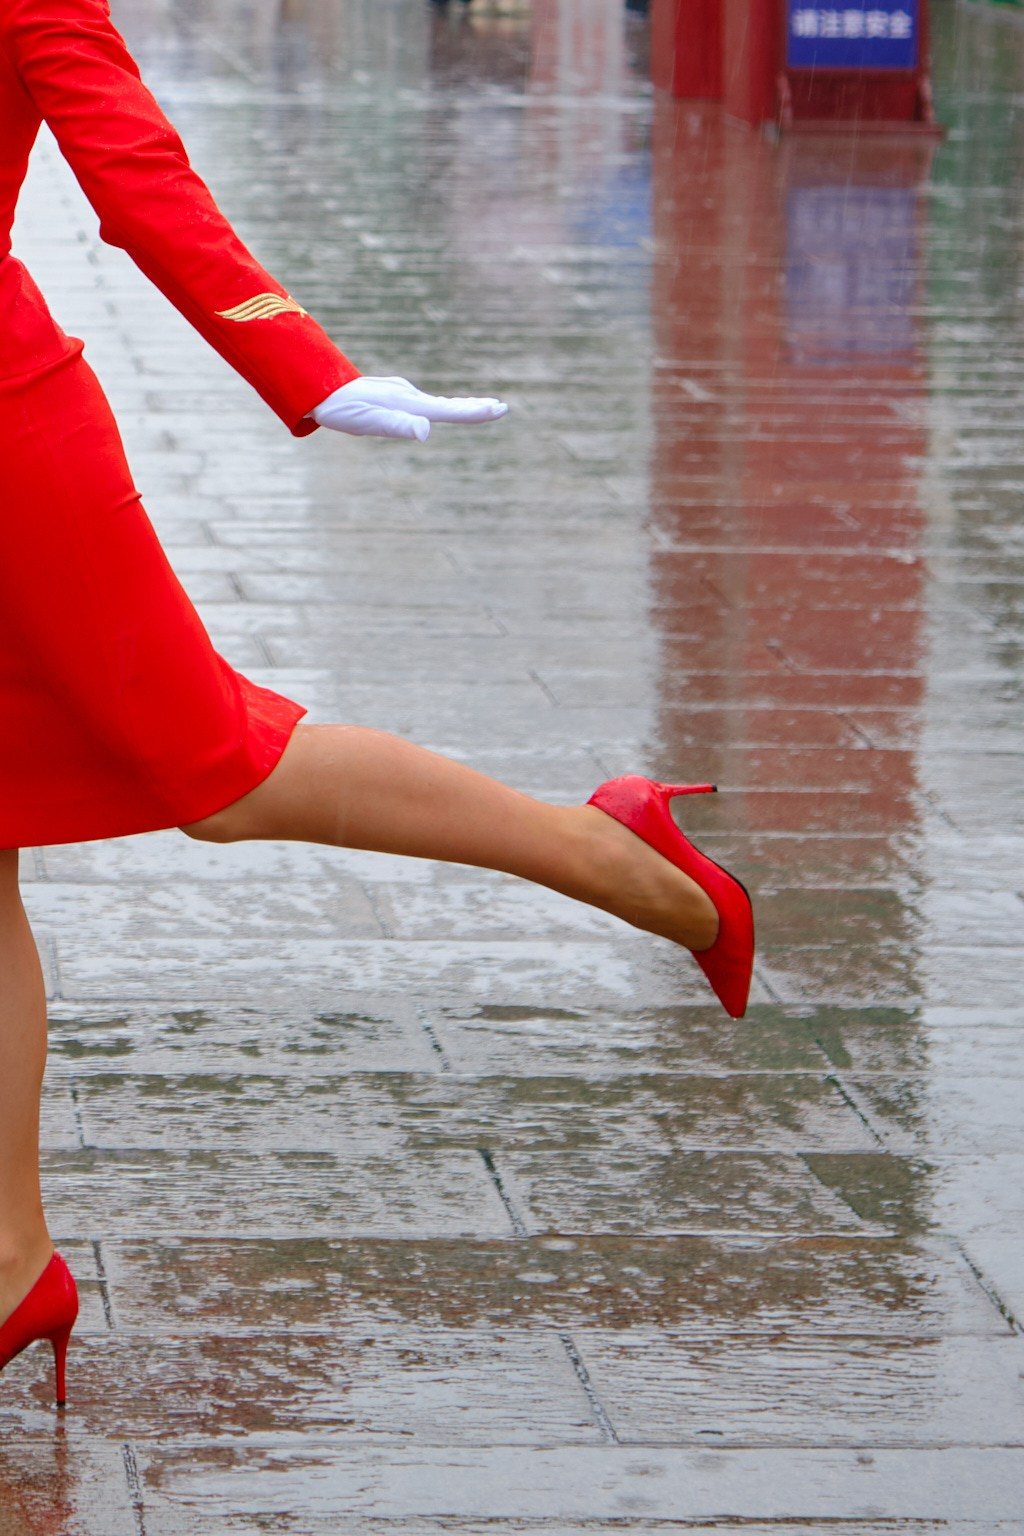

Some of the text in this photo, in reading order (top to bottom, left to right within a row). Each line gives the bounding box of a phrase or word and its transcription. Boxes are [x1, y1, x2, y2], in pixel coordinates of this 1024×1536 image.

[792, 9, 912, 40] 请注意安全
